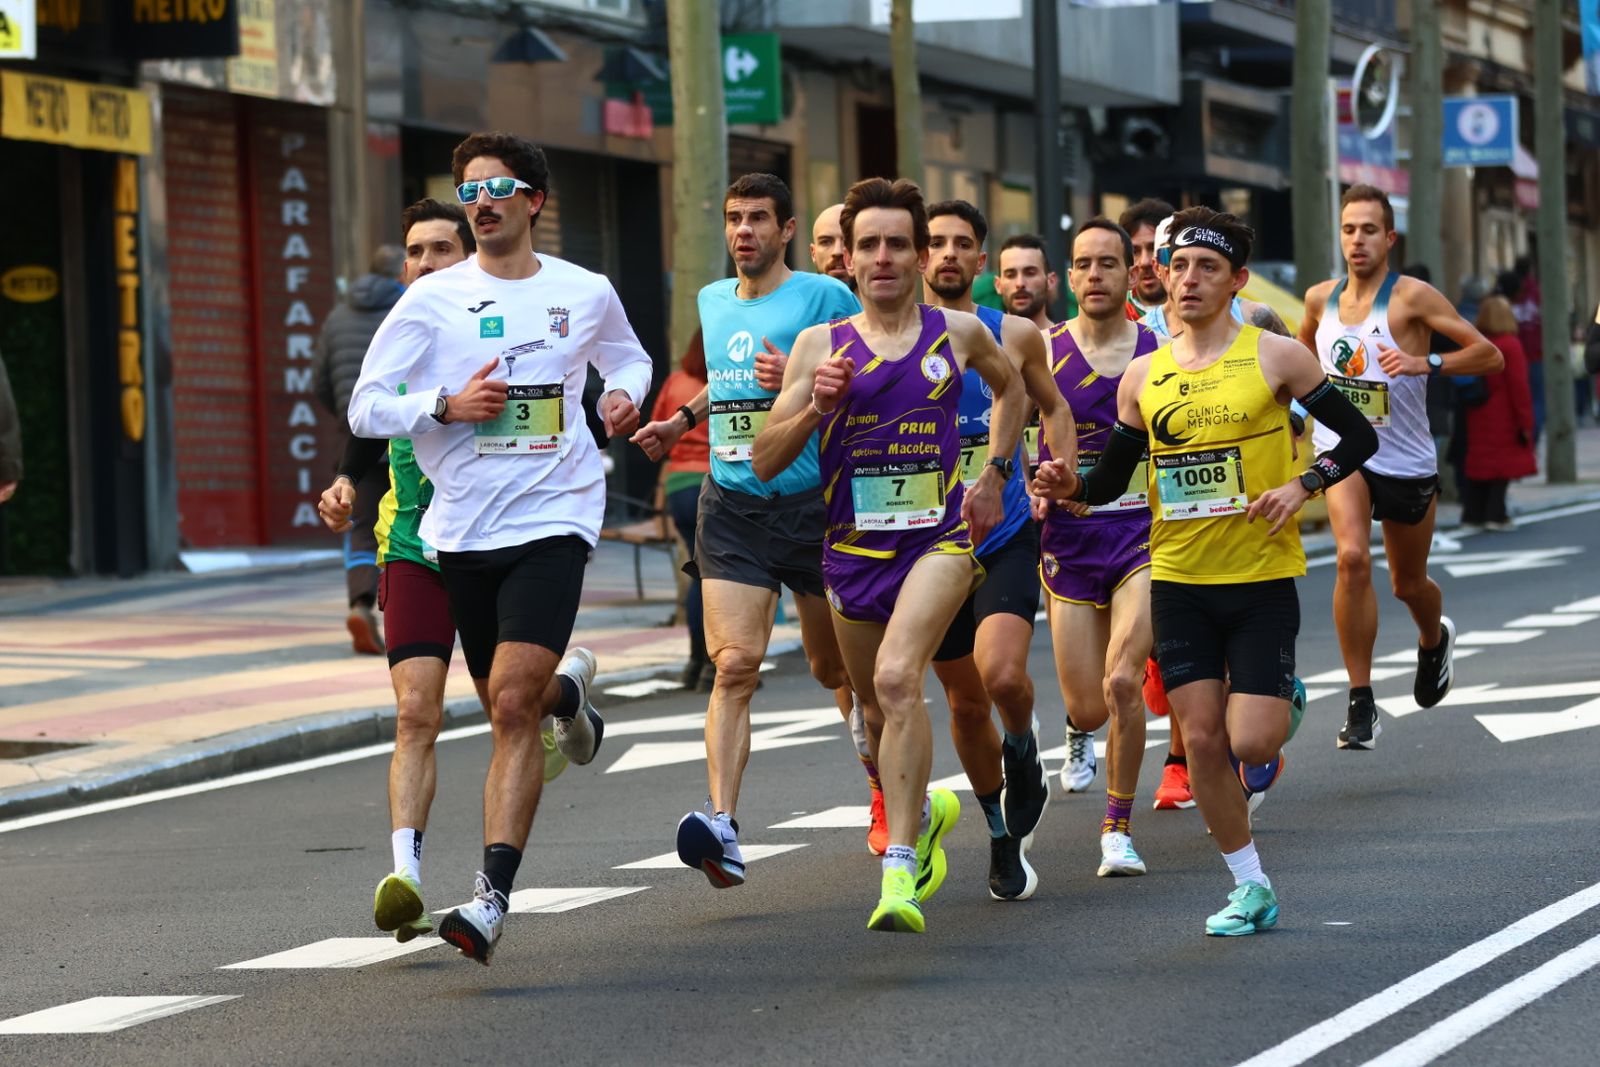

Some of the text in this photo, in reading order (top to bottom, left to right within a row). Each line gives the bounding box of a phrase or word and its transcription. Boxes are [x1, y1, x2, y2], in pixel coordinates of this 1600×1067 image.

[1194, 234, 1234, 254] MENORCA
[280, 134, 320, 527] PARAFARMACIA
[516, 403, 530, 421] 3
[1187, 404, 1229, 418] CLÍNICA
[729, 415, 752, 431] 13
[898, 422, 937, 434] PRIM
[1187, 412, 1249, 429] MENORCA
[888, 441, 941, 455] Macotera
[1172, 466, 1227, 488] 1008
[892, 479, 906, 497] 7
[908, 517, 938, 526] bedunia
